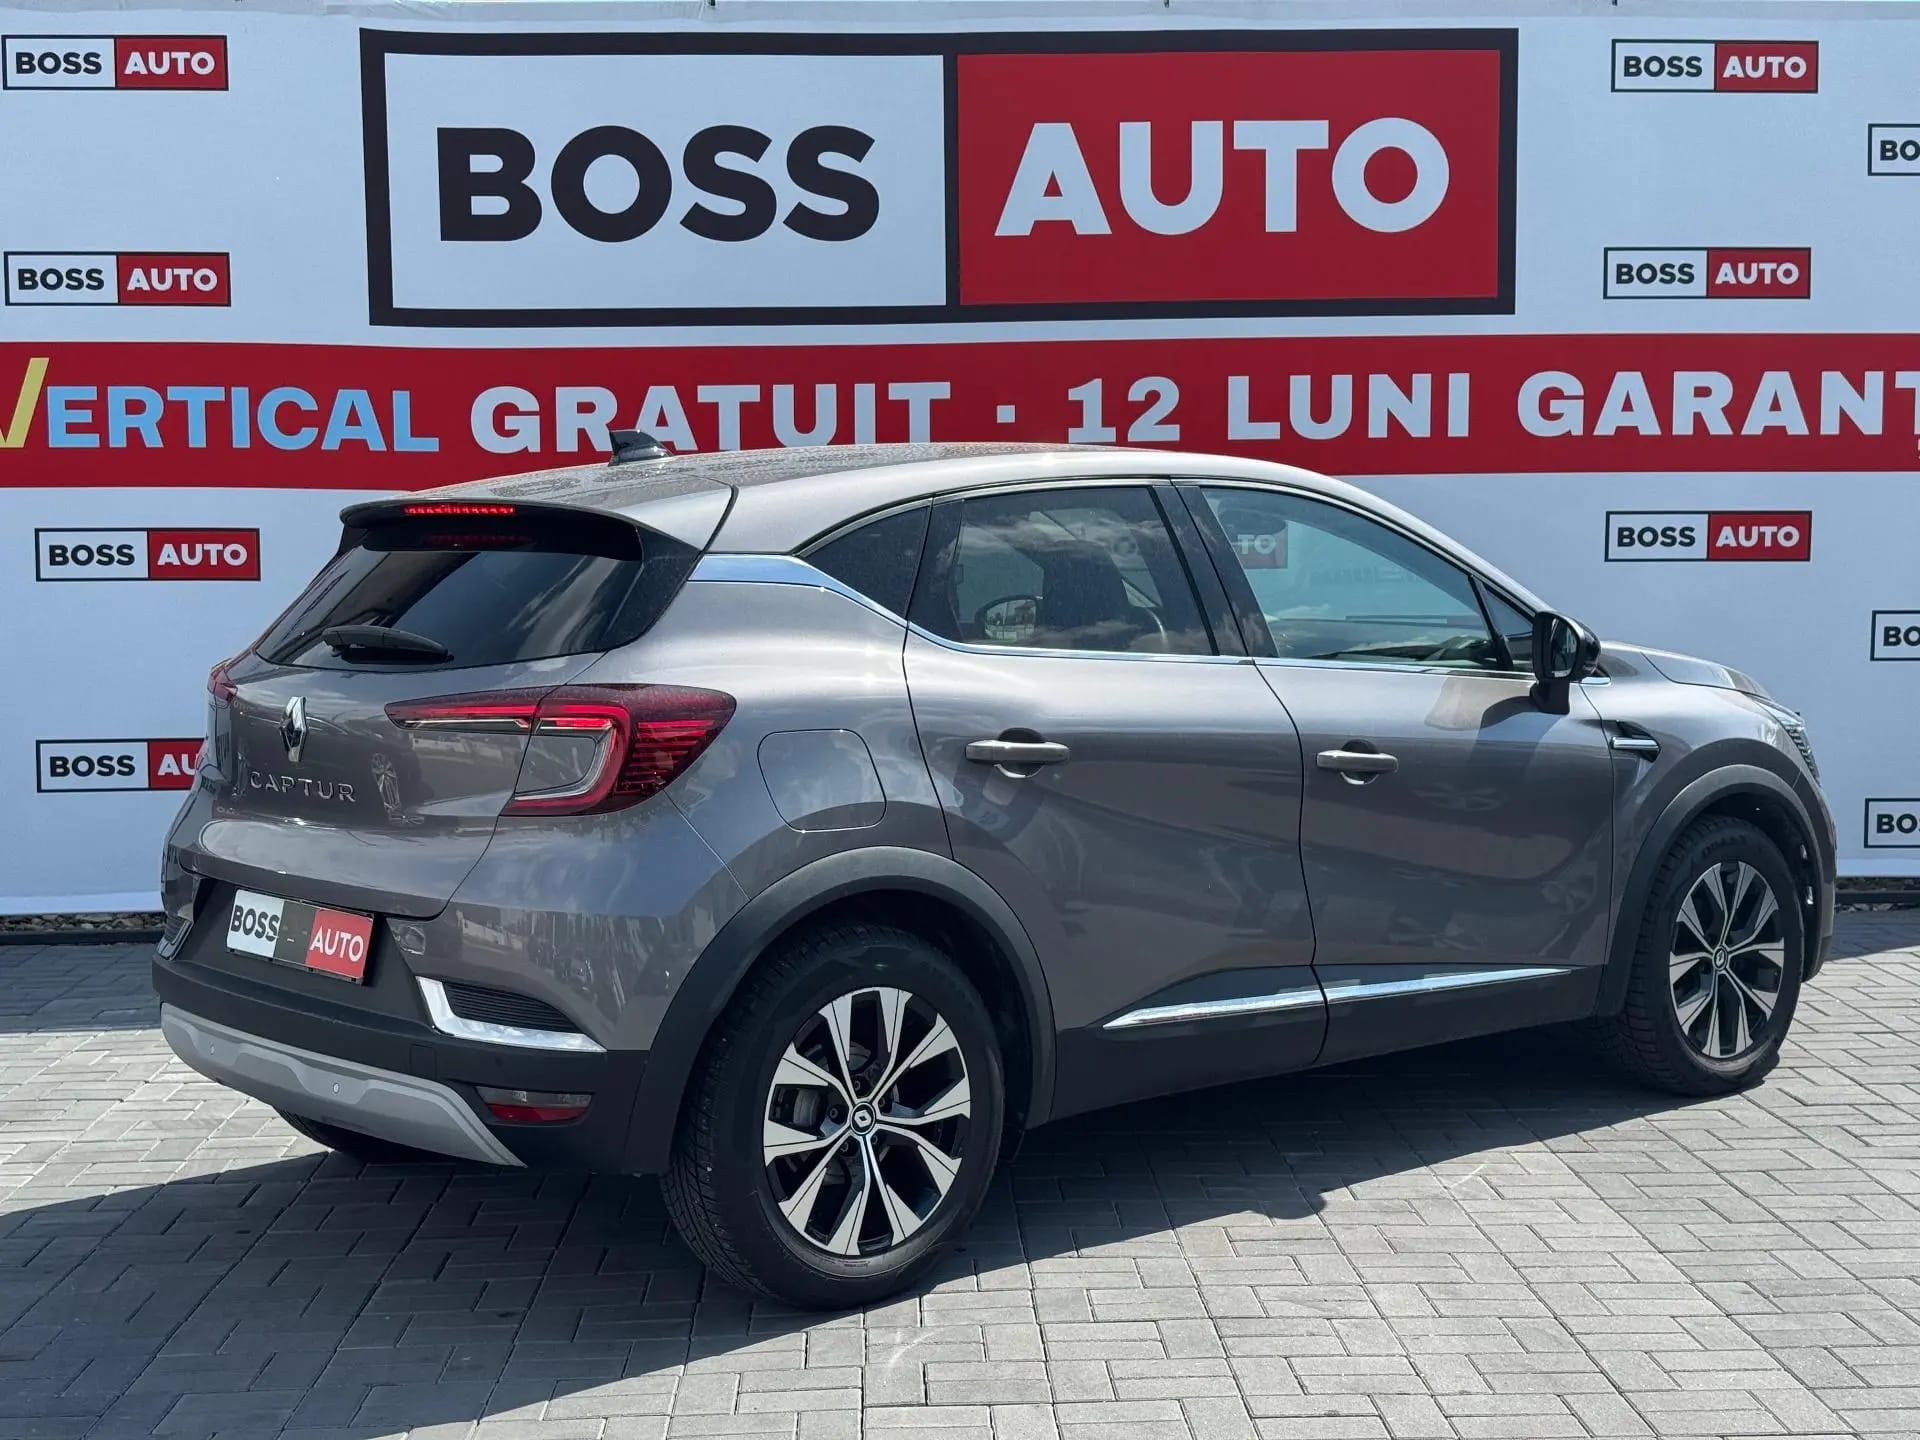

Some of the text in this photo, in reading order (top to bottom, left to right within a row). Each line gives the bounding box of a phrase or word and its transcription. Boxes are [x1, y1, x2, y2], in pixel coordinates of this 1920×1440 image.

[16, 51, 215, 75] BOSS AUTO
[1623, 56, 1807, 79] BOSS AUTO
[437, 117, 1450, 242] BOSS AUTO
[17, 267, 218, 292] BOSS AUTO
[1615, 262, 1799, 285] BOSS AUTO
[471, 381, 951, 453] GRATUIT
[1067, 377, 1180, 444] 12
[1227, 372, 1470, 440] LUNI
[1617, 526, 1800, 548] BOSS AUTO
[49, 543, 248, 567] BOSS AUTO
[49, 755, 136, 778] BOSS
[250, 771, 356, 803] CAPTUR
[1876, 813, 1920, 835] BO
[231, 905, 364, 962] BOSS AUTO
